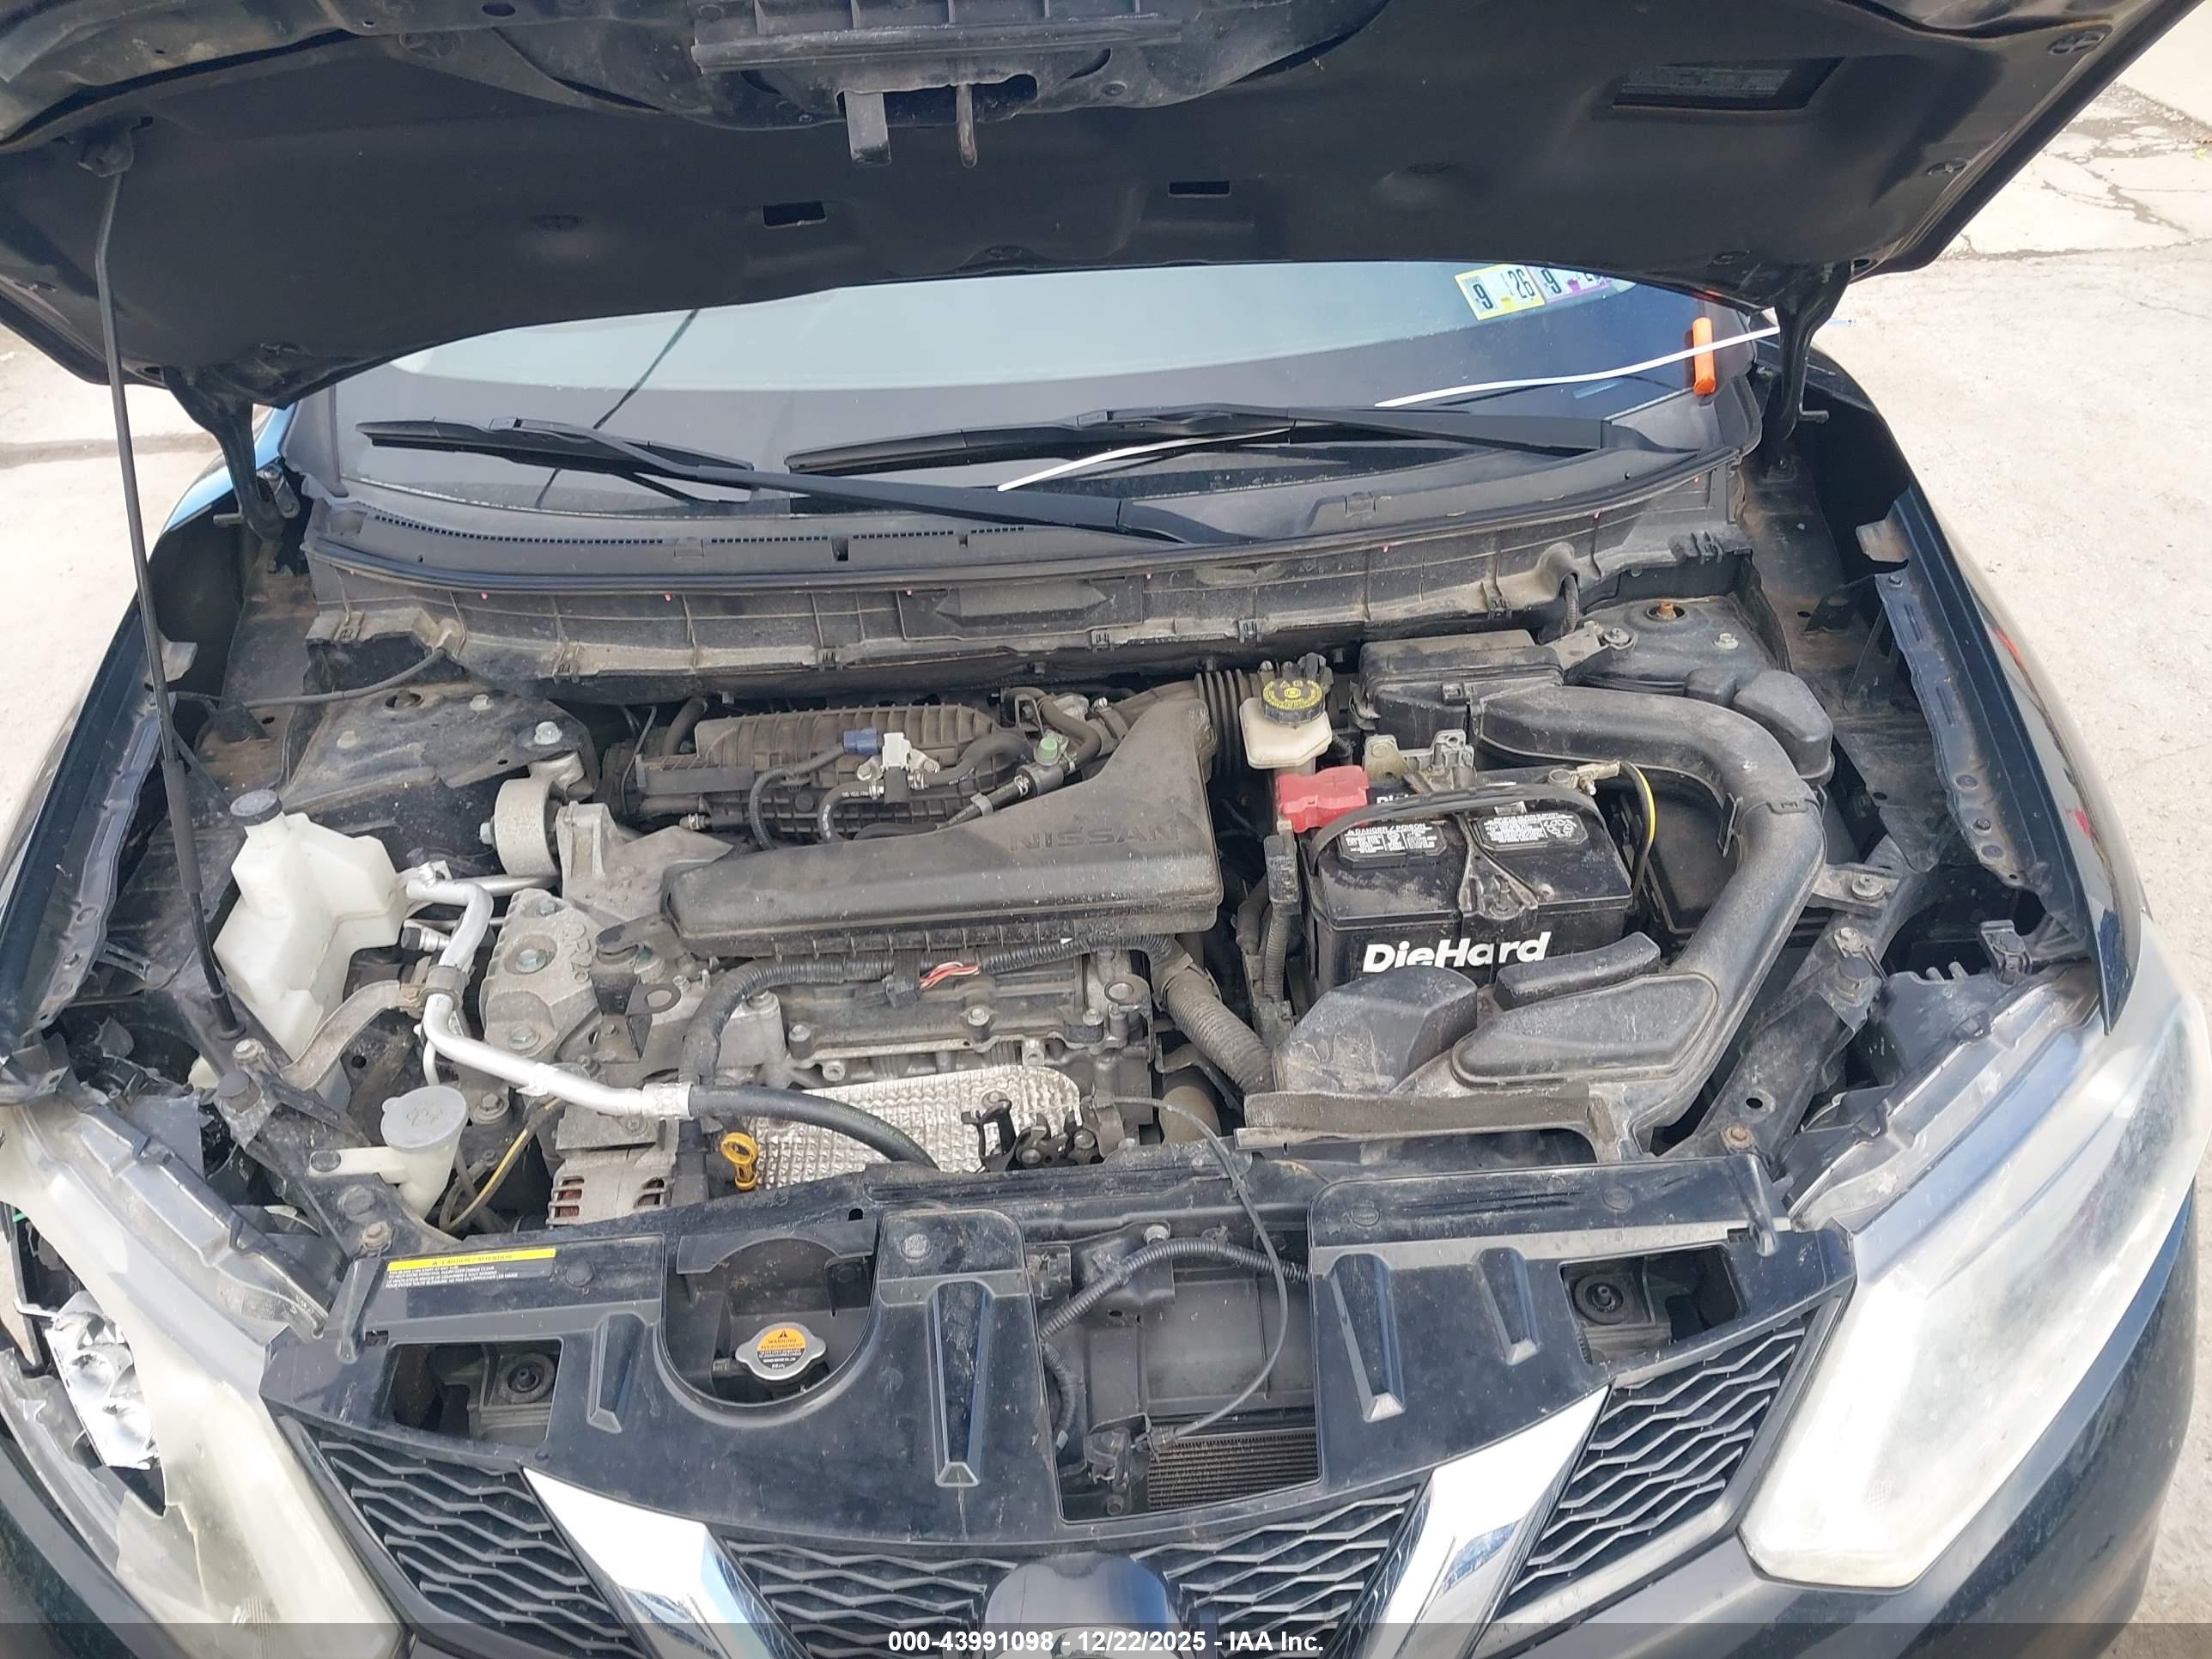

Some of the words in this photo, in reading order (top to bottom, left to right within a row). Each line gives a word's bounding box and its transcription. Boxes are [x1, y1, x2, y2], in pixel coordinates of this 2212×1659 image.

[1473, 283, 1494, 310] 9
[1508, 268, 1535, 299] 26
[1540, 269, 1563, 294] 9
[1008, 822, 1181, 853] NISSAN
[1354, 825, 1389, 836] DANGER
[1395, 822, 1426, 832] POISON
[1363, 931, 1553, 974] DieHard
